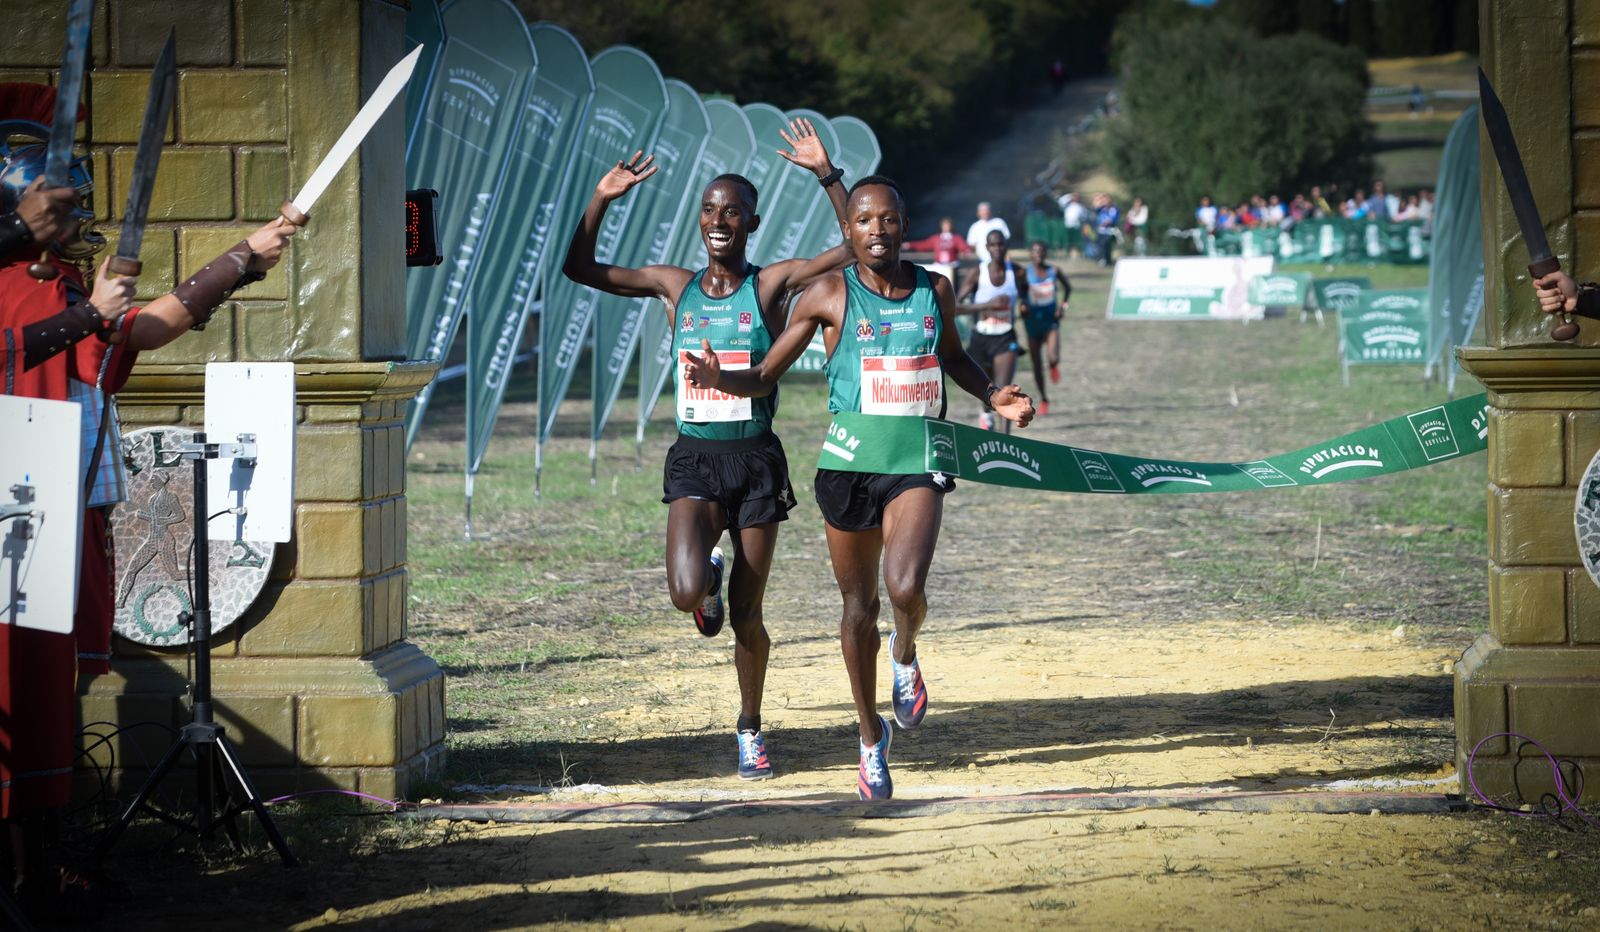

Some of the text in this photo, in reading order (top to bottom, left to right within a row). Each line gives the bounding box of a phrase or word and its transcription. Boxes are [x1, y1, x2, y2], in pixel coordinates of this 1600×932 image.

[555, 298, 590, 369] CROSS
[607, 309, 640, 375] CROSS
[485, 311, 519, 389] CROSS
[872, 377, 939, 407] Ndikumwenayo
[972, 440, 1040, 472] DIPUTACION
[1424, 435, 1451, 447] SEVILLA
[1131, 463, 1207, 480] DIPUTACION
[1299, 445, 1379, 473] DIPUTACION
